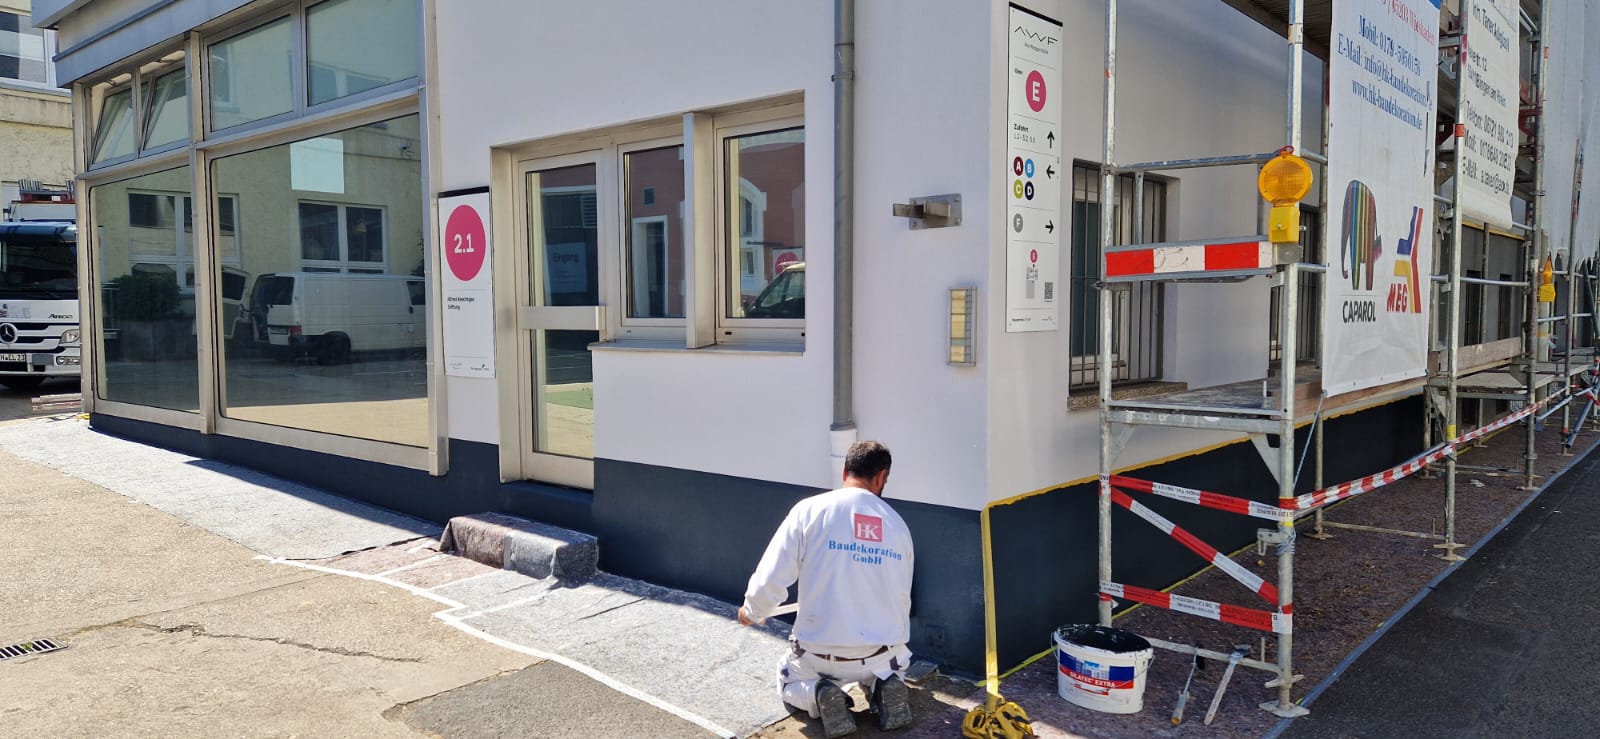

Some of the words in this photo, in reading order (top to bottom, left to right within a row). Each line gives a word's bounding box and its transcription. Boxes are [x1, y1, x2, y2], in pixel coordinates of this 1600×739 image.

[1032, 80, 1041, 102] E
[1016, 161, 1022, 173] A
[1026, 163, 1033, 174] B
[1015, 184, 1022, 194] C
[1026, 185, 1033, 196] D
[454, 233, 474, 254] 2.1
[1387, 283, 1408, 313] MEG
[1342, 300, 1376, 323] CAPAROL
[855, 523, 881, 540] HK
[829, 540, 902, 561] Baudekoration
[853, 553, 882, 565] GmbH
[1094, 679, 1116, 688] EXTRA
